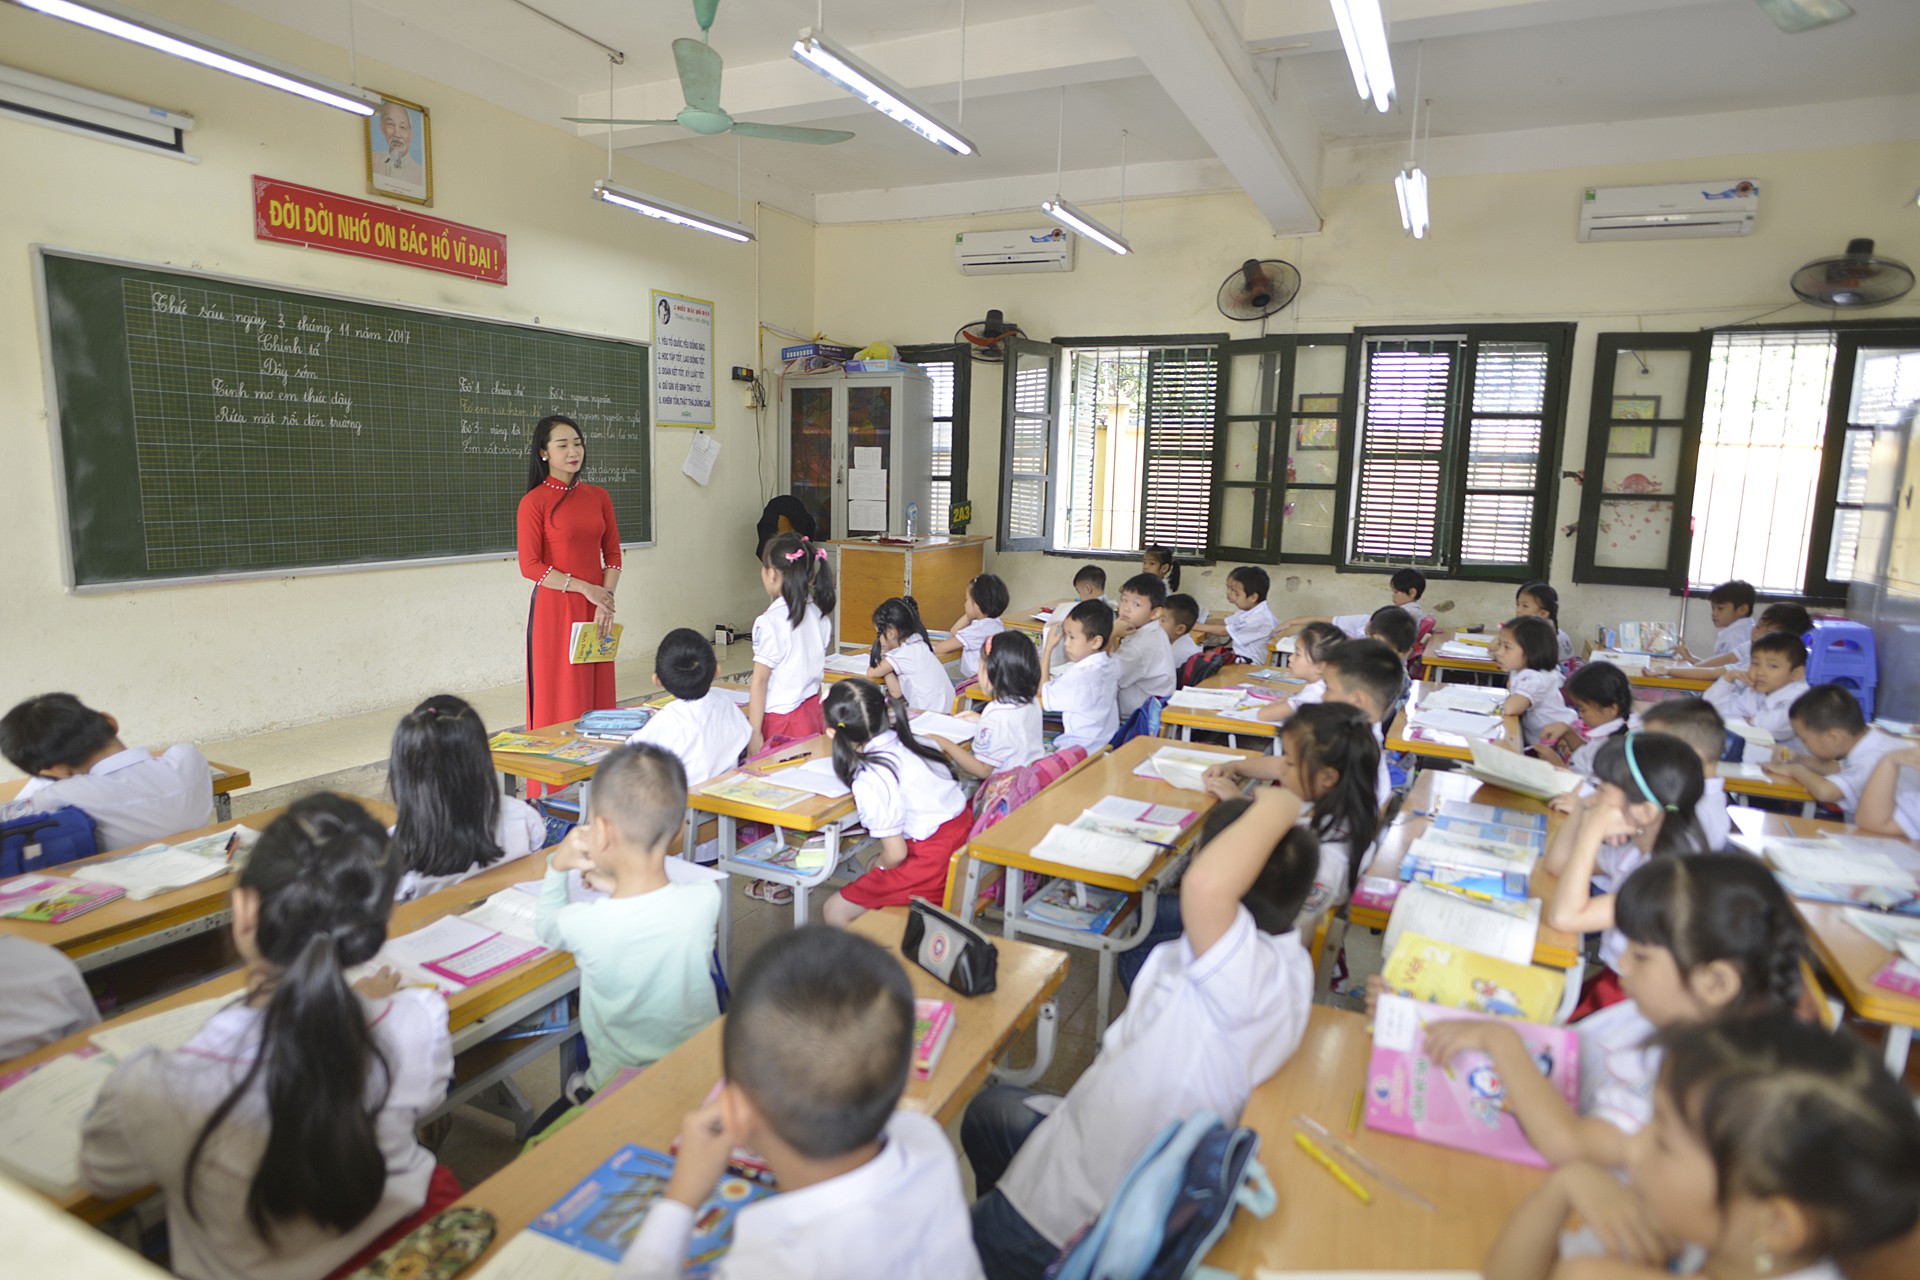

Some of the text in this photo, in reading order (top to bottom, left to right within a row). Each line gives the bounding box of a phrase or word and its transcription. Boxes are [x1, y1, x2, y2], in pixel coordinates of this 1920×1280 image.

[269, 195, 301, 230] ĐỜI
[304, 202, 334, 237] ĐỜI
[338, 212, 371, 244] NHỚ
[374, 222, 396, 250] ƠN
[400, 224, 428, 256] BÁC
[432, 228, 450, 261] HỒ
[453, 236, 466, 265] VĨ
[469, 244, 491, 275] ĐẠI
[152, 292, 411, 344] Thứ sáu ngày 3 tháng 11 năm 2017
[258, 333, 302, 354] Chính
[260, 358, 318, 386] Dậy sớm
[279, 392, 298, 401] em
[304, 388, 328, 404] thức
[331, 391, 353, 413] dậy
[254, 412, 275, 428] mặt
[953, 506, 970, 523] 2A3
[1424, 944, 1452, 965] 2
